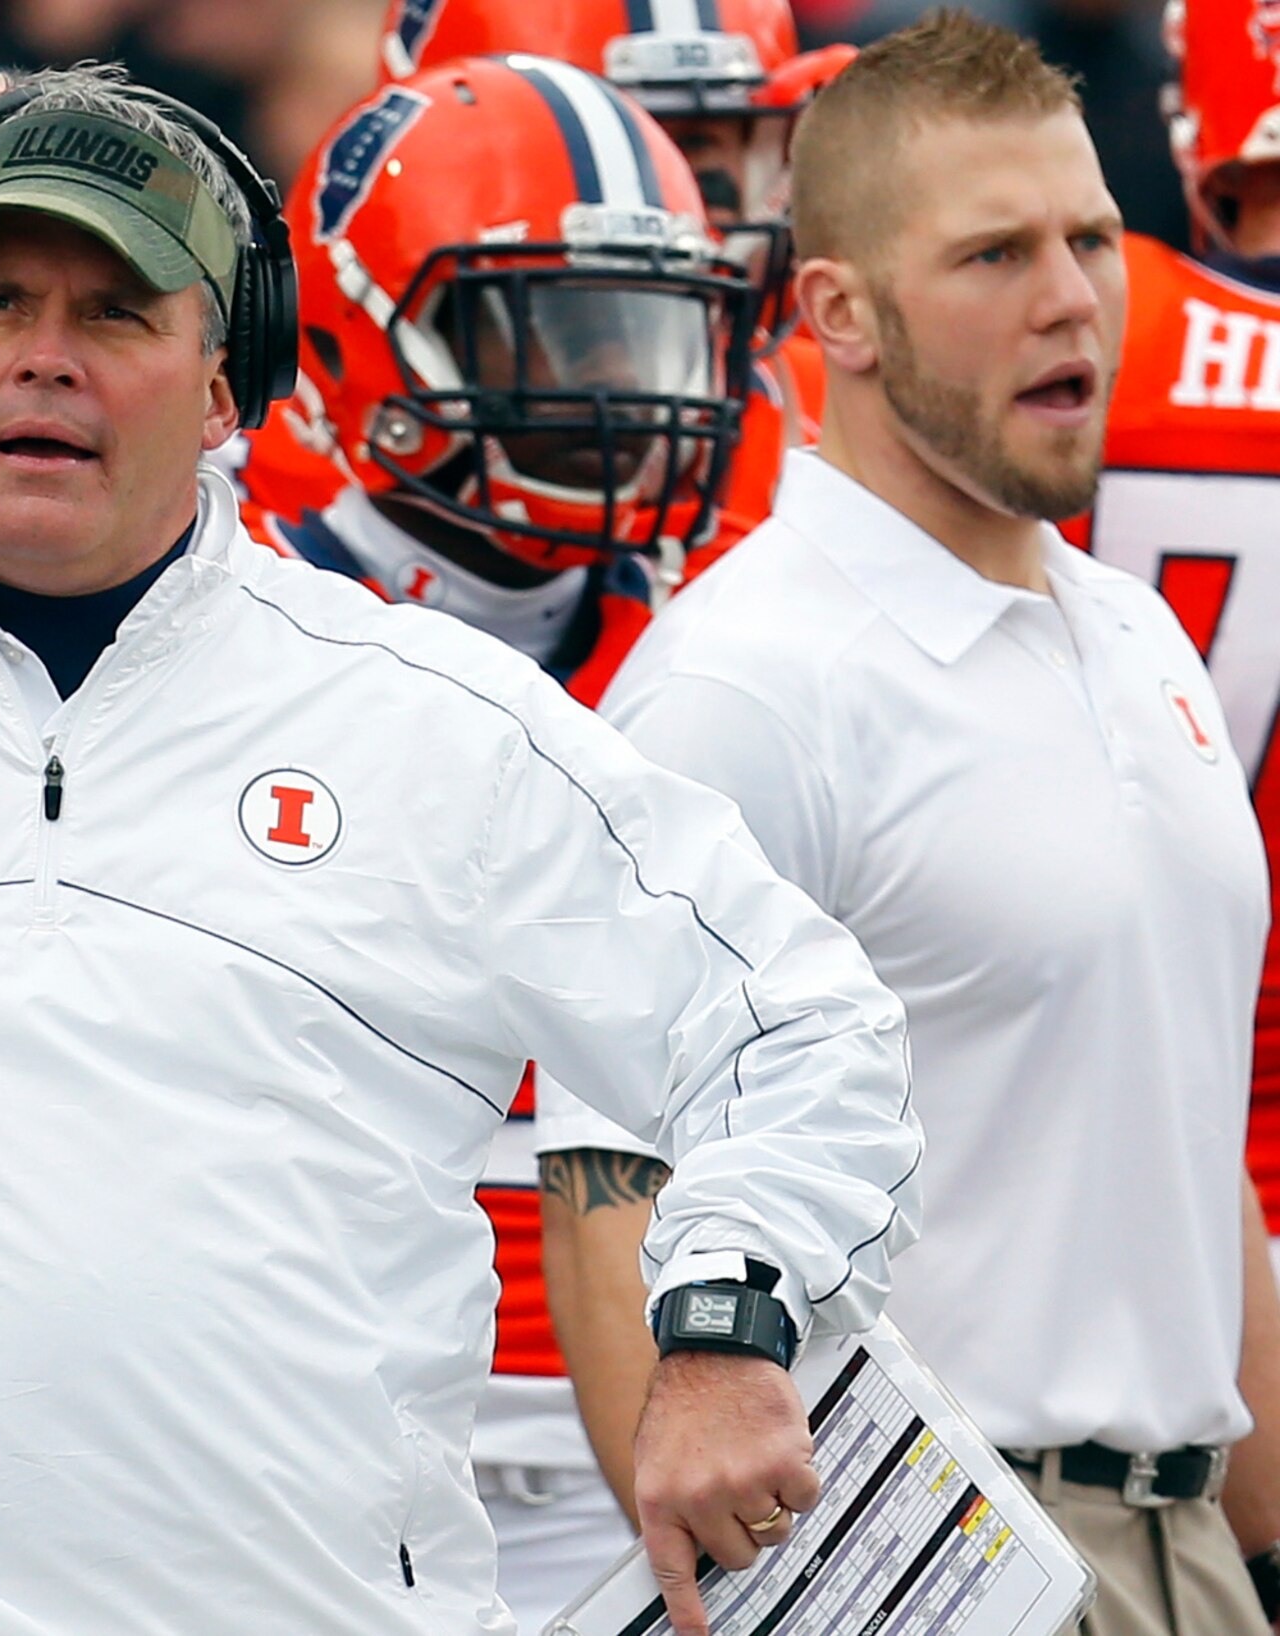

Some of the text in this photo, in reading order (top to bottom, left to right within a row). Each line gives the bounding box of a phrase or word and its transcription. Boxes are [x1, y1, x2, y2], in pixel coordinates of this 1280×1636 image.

[10, 125, 159, 183] ILLINOIS
[267, 785, 313, 847] I
[689, 1296, 712, 1327] 20
